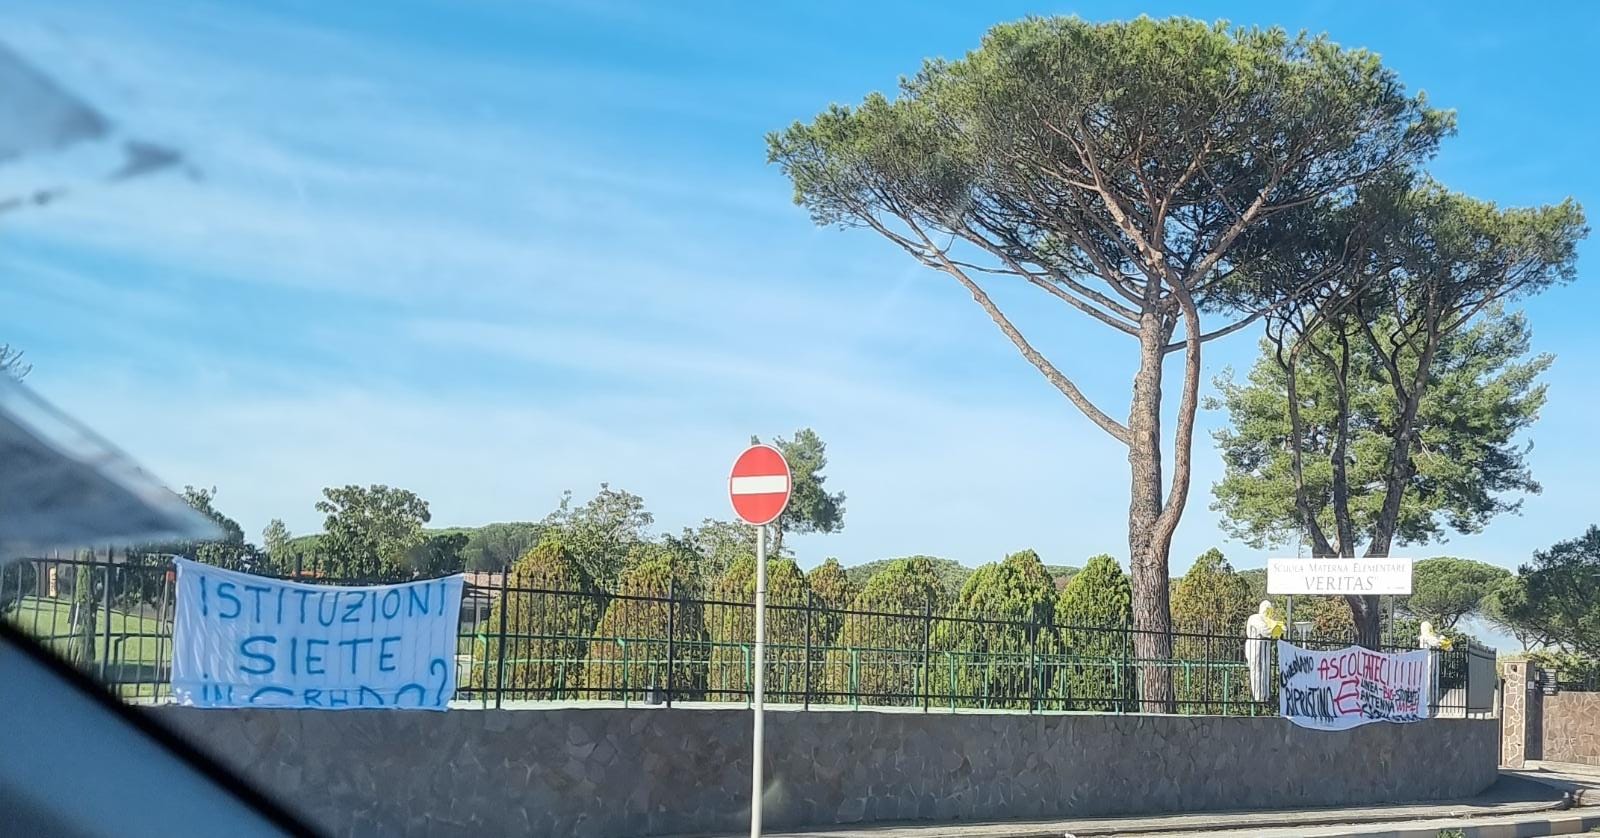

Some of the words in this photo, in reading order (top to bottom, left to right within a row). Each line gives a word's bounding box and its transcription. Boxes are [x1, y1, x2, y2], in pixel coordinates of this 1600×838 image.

[1309, 562, 1348, 573] MATERNA
[1353, 562, 1405, 573] ELEMENTARE
[199, 575, 446, 627] ISTITUZIONI
[239, 635, 402, 675] SIETE
